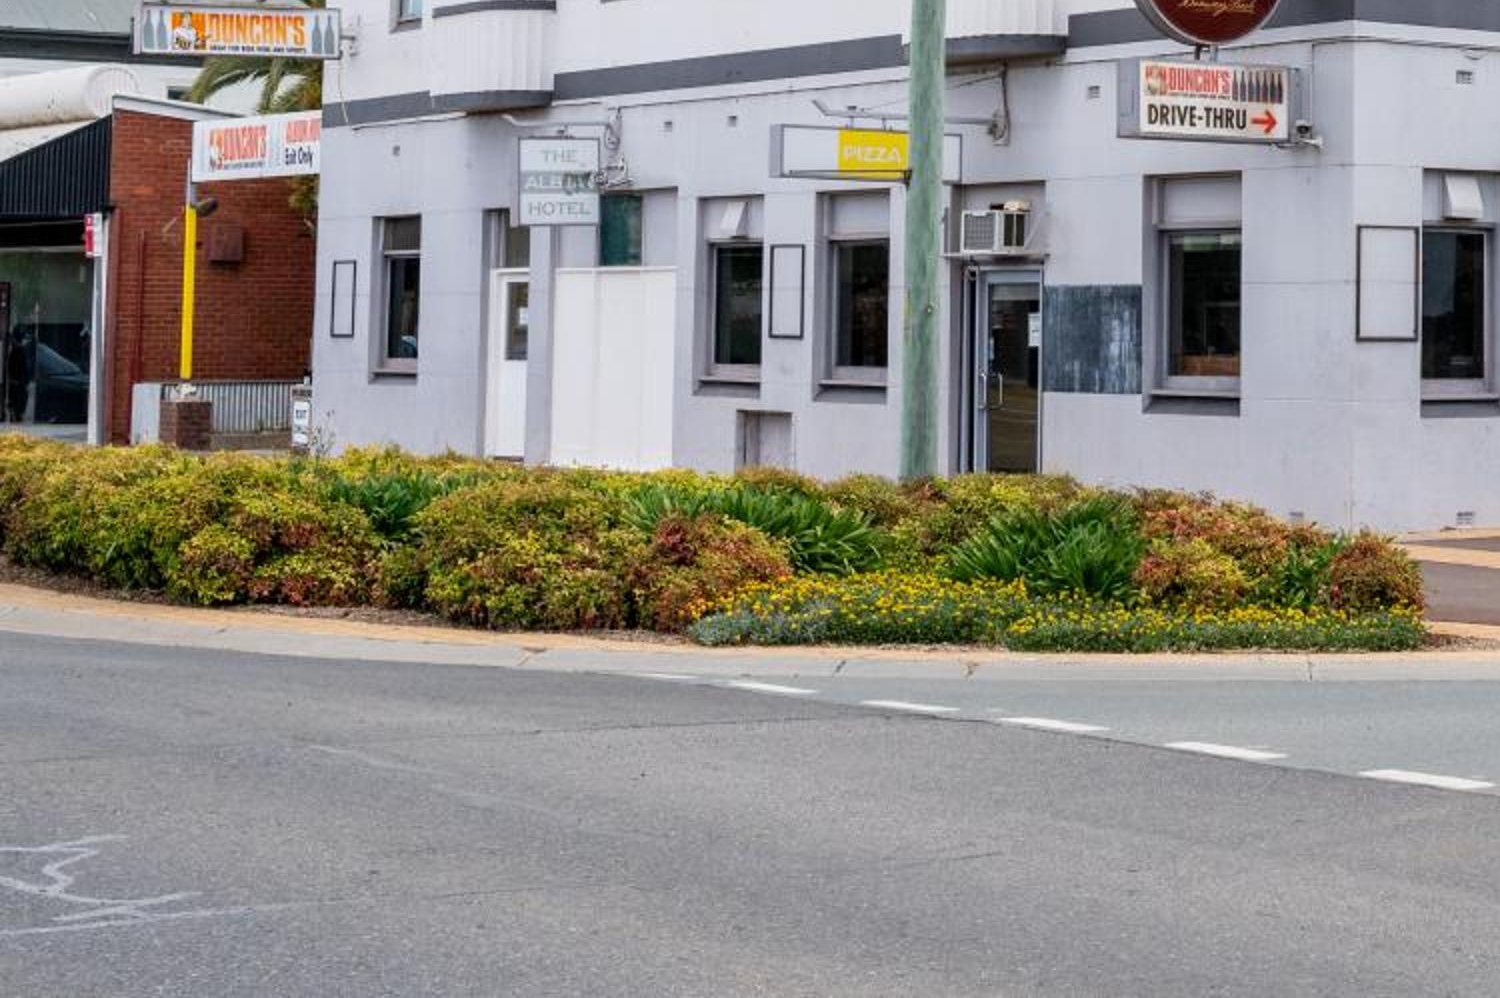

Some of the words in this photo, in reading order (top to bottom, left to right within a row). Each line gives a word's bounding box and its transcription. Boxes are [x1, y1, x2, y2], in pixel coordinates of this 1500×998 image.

[207, 12, 306, 46] DUNCAN'S
[1167, 67, 1231, 94] DUNCAN'S
[1147, 103, 1247, 130] DRIVE-THRU
[543, 149, 577, 163] THE
[844, 144, 902, 163] PIZZA
[528, 201, 592, 216] HOTEL
